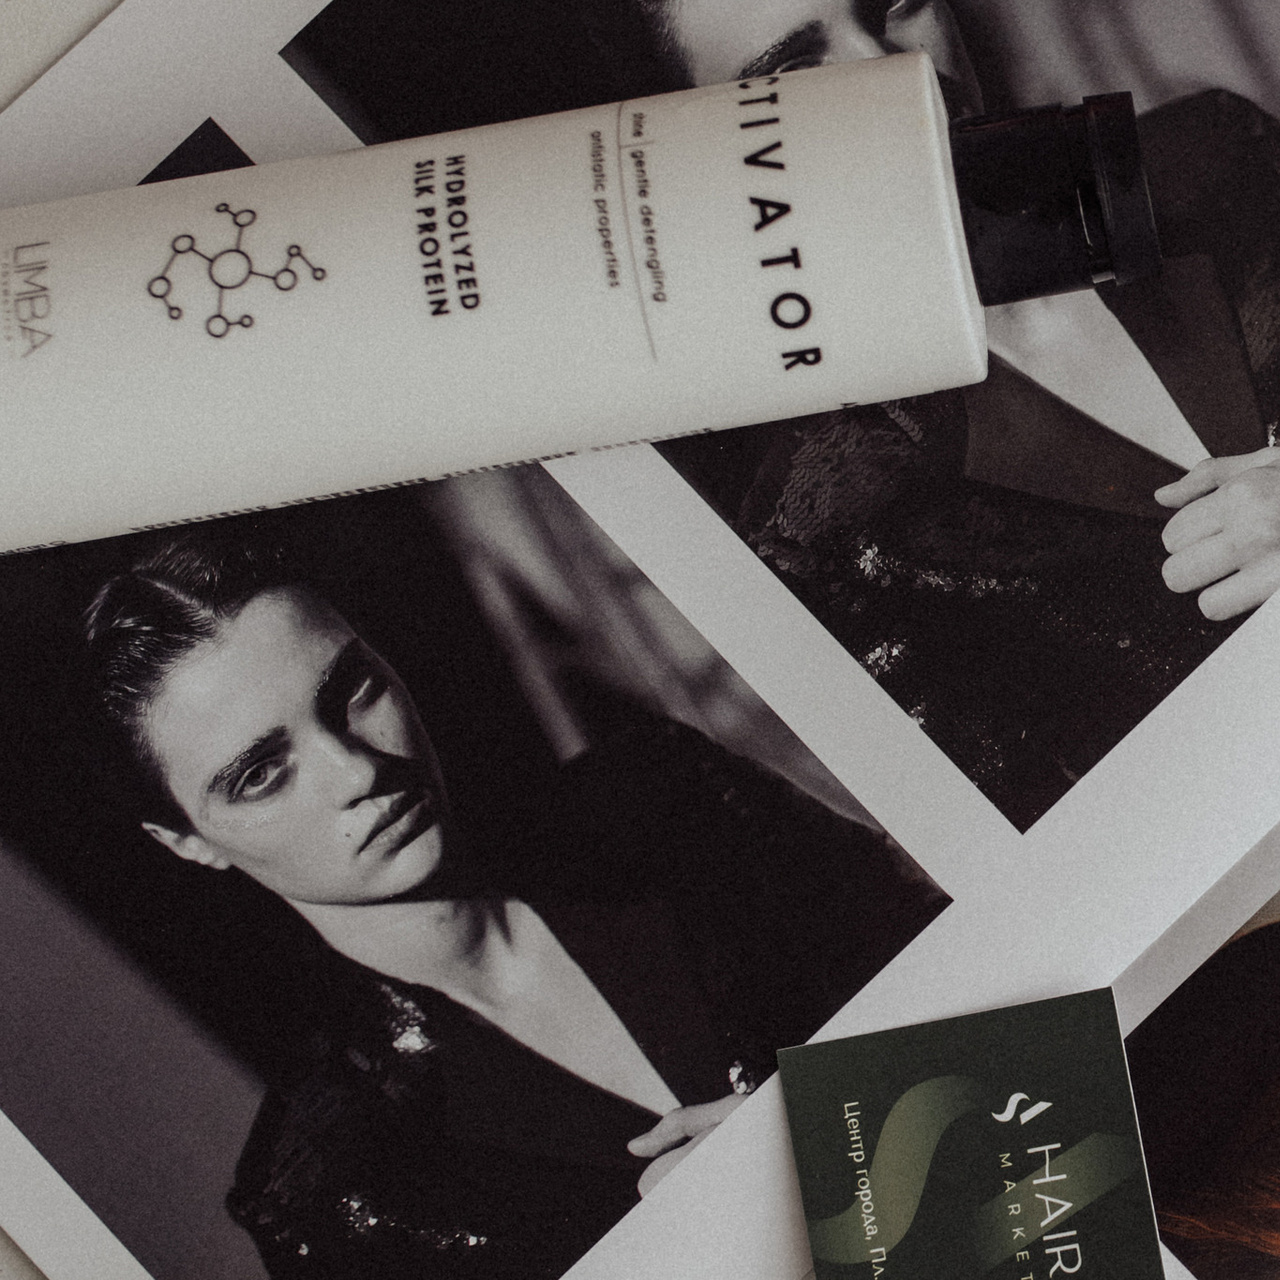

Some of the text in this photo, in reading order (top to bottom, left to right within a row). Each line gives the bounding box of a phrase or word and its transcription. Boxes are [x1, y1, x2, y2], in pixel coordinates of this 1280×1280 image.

[629, 149, 652, 199] gentle
[414, 159, 451, 317] SILK PROTEIN
[445, 154, 480, 311] HYDROLYZED
[593, 197, 622, 287] properties
[12, 240, 53, 359] LIMBA
[839, 1100, 870, 1164] Центр
[850, 1167, 881, 1242] города,
[1024, 1141, 1085, 1279] HAIR
